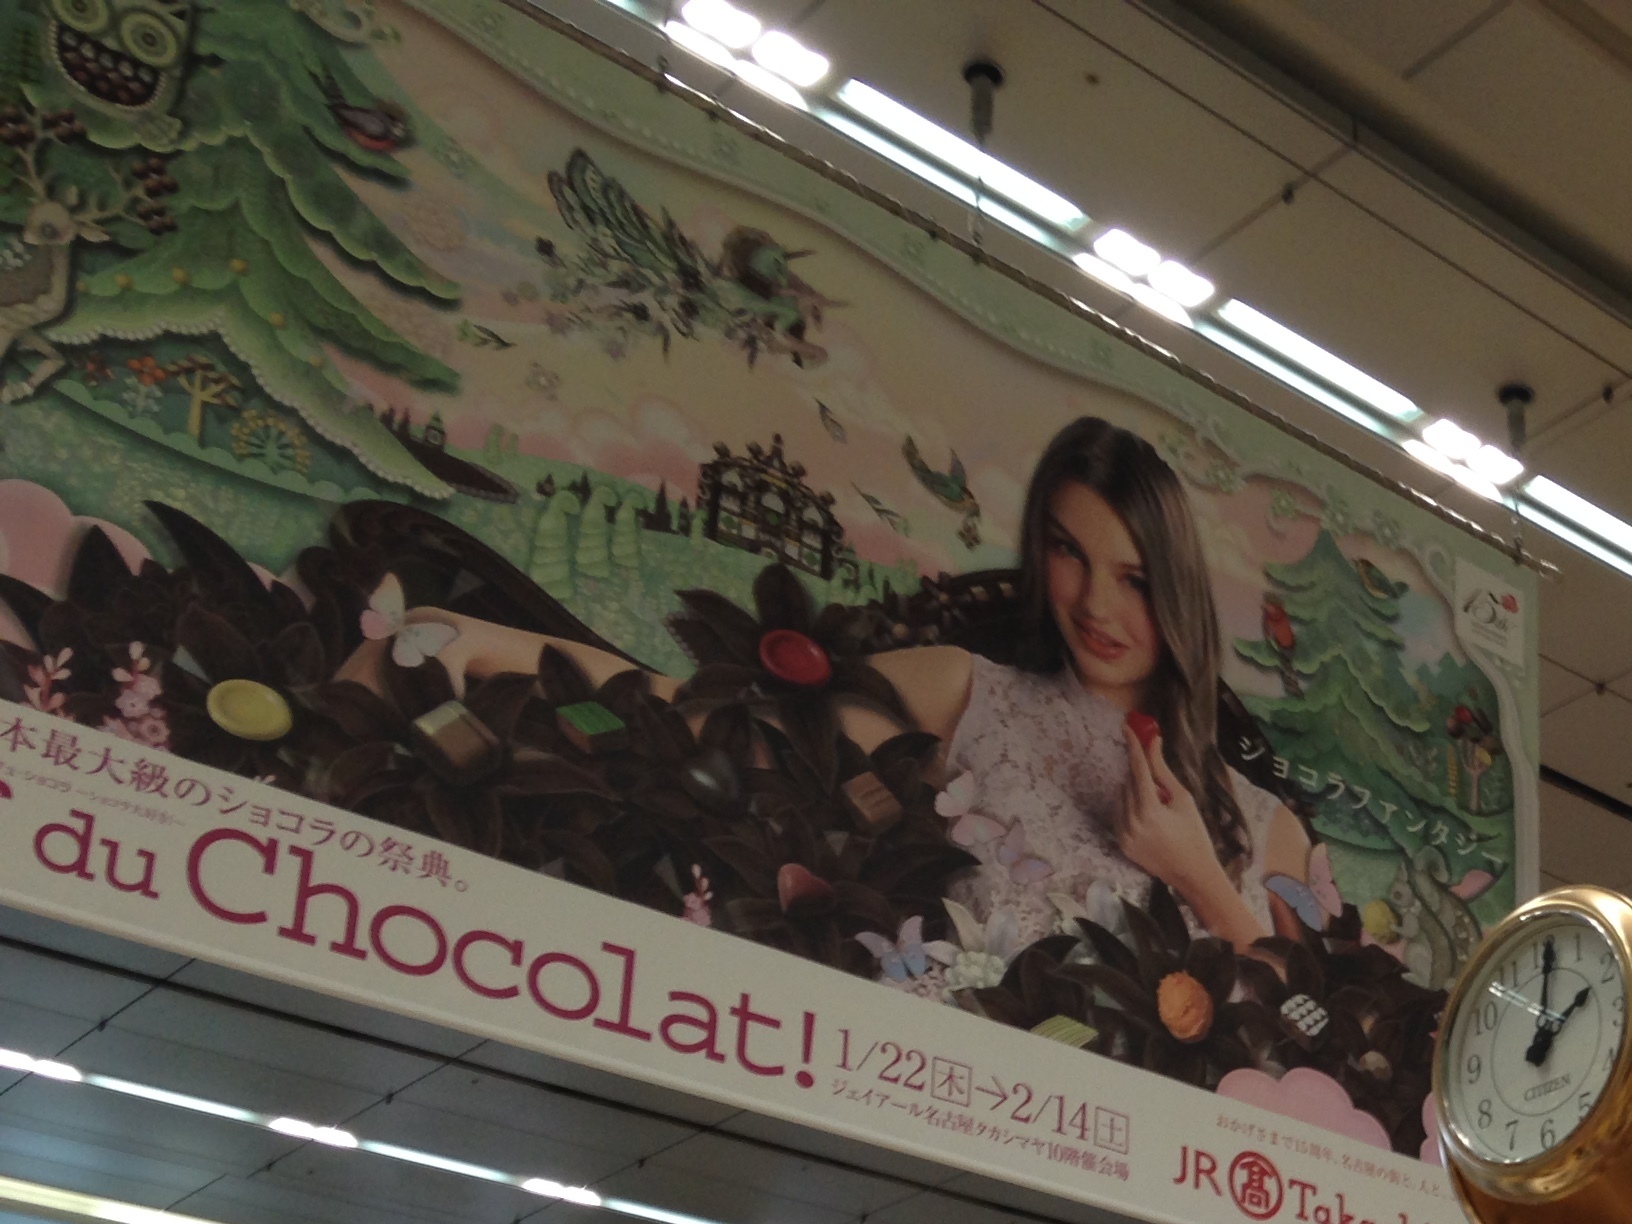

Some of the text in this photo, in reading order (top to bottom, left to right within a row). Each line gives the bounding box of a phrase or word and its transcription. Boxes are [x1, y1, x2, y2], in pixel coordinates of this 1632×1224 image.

[33, 808, 816, 1089] du Chocolat!
[1523, 1073, 1572, 1102] CITIZEN
